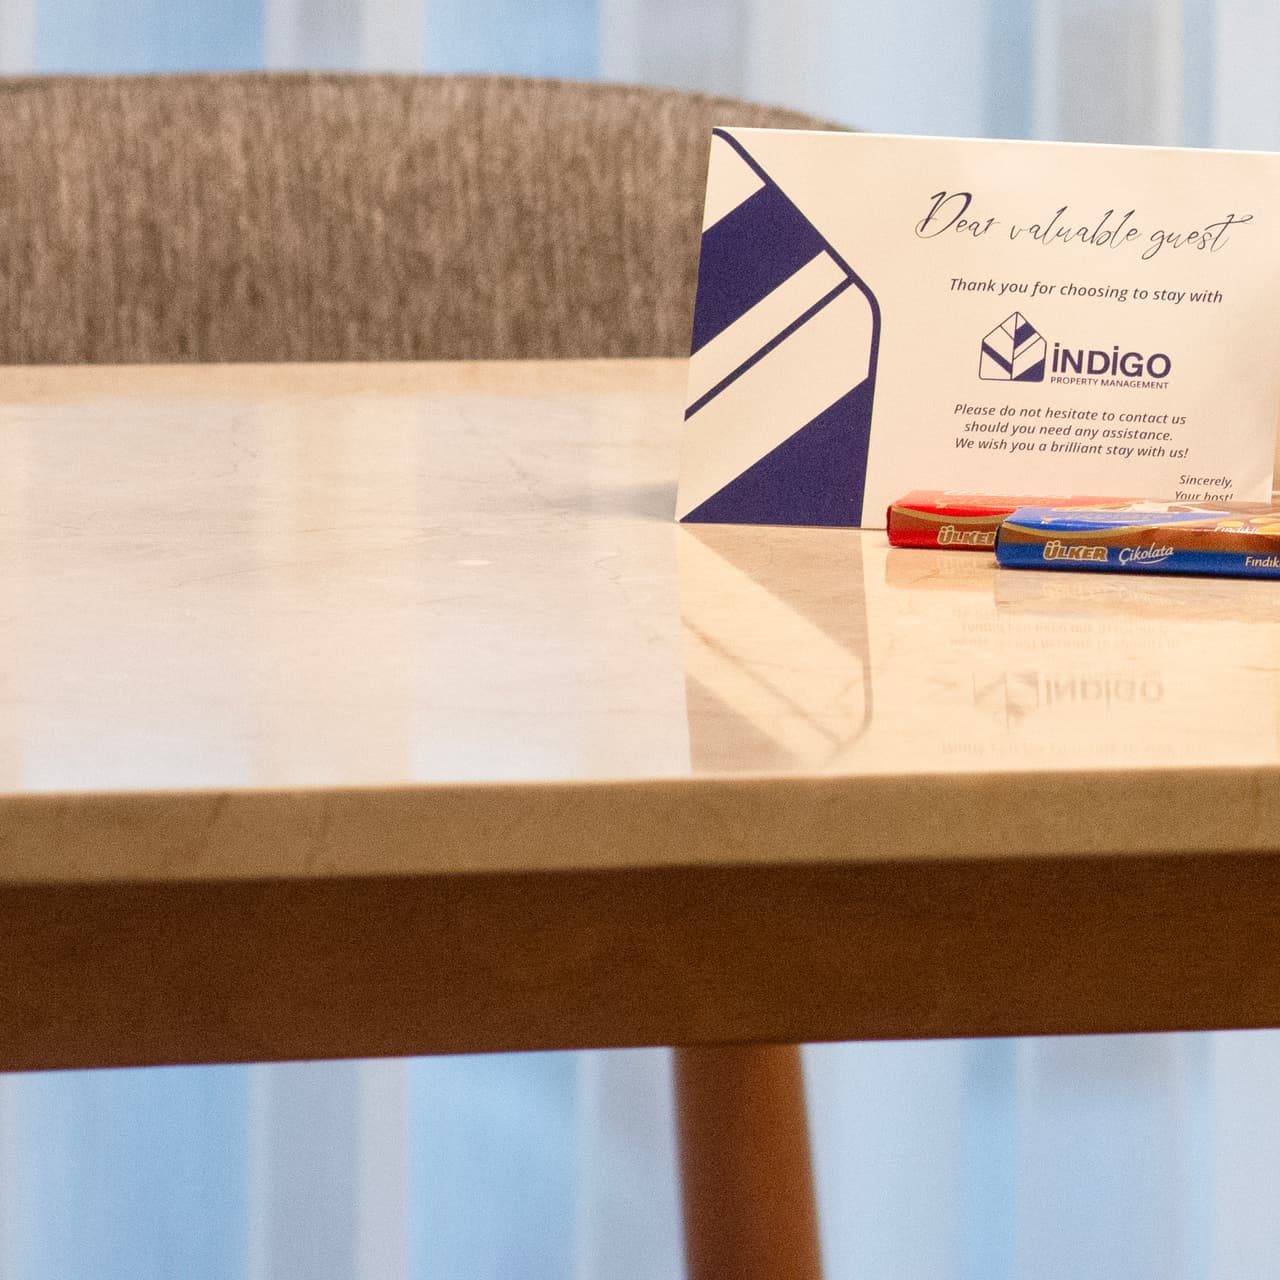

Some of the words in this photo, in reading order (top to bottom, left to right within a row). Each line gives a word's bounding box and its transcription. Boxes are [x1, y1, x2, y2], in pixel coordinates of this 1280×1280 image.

[915, 191, 1001, 239] Dear
[1009, 206, 1142, 249] valuable
[1141, 214, 1254, 260] guest
[950, 278, 996, 292] Thank
[998, 282, 1028, 296] you
[1030, 281, 1056, 297] for
[1060, 283, 1128, 302] choosing
[1133, 288, 1148, 300] to
[1152, 289, 1186, 304] stay
[1190, 290, 1223, 303] with
[1050, 376, 1098, 387] PROPERTY
[1100, 379, 1169, 390] MANAGEMENT
[954, 403, 996, 416] Please
[1000, 405, 1016, 417] do
[1020, 408, 1042, 418] not
[1045, 407, 1098, 420] hesitate
[1102, 411, 1115, 422] to
[1119, 413, 1168, 424] contact
[1171, 416, 1187, 425] us
[964, 421, 1009, 433] should
[1010, 424, 1036, 436] you
[1039, 425, 1072, 436] need
[1074, 427, 1099, 440] any
[1102, 428, 1173, 441] assistance.
[955, 438, 974, 449] We
[978, 439, 1007, 450] wish
[1009, 441, 1035, 454] you
[1038, 443, 1047, 452] a
[1050, 441, 1102, 454] brilliant
[1105, 445, 1134, 459] stay
[1137, 446, 1165, 457] with
[1169, 448, 1189, 459] us!
[1179, 475, 1233, 489] Sincerely,
[1175, 491, 1201, 501] Your
[1203, 492, 1234, 502] host!
[1043, 540, 1108, 562] ÜLKER
[1118, 543, 1174, 565] Çikolata
